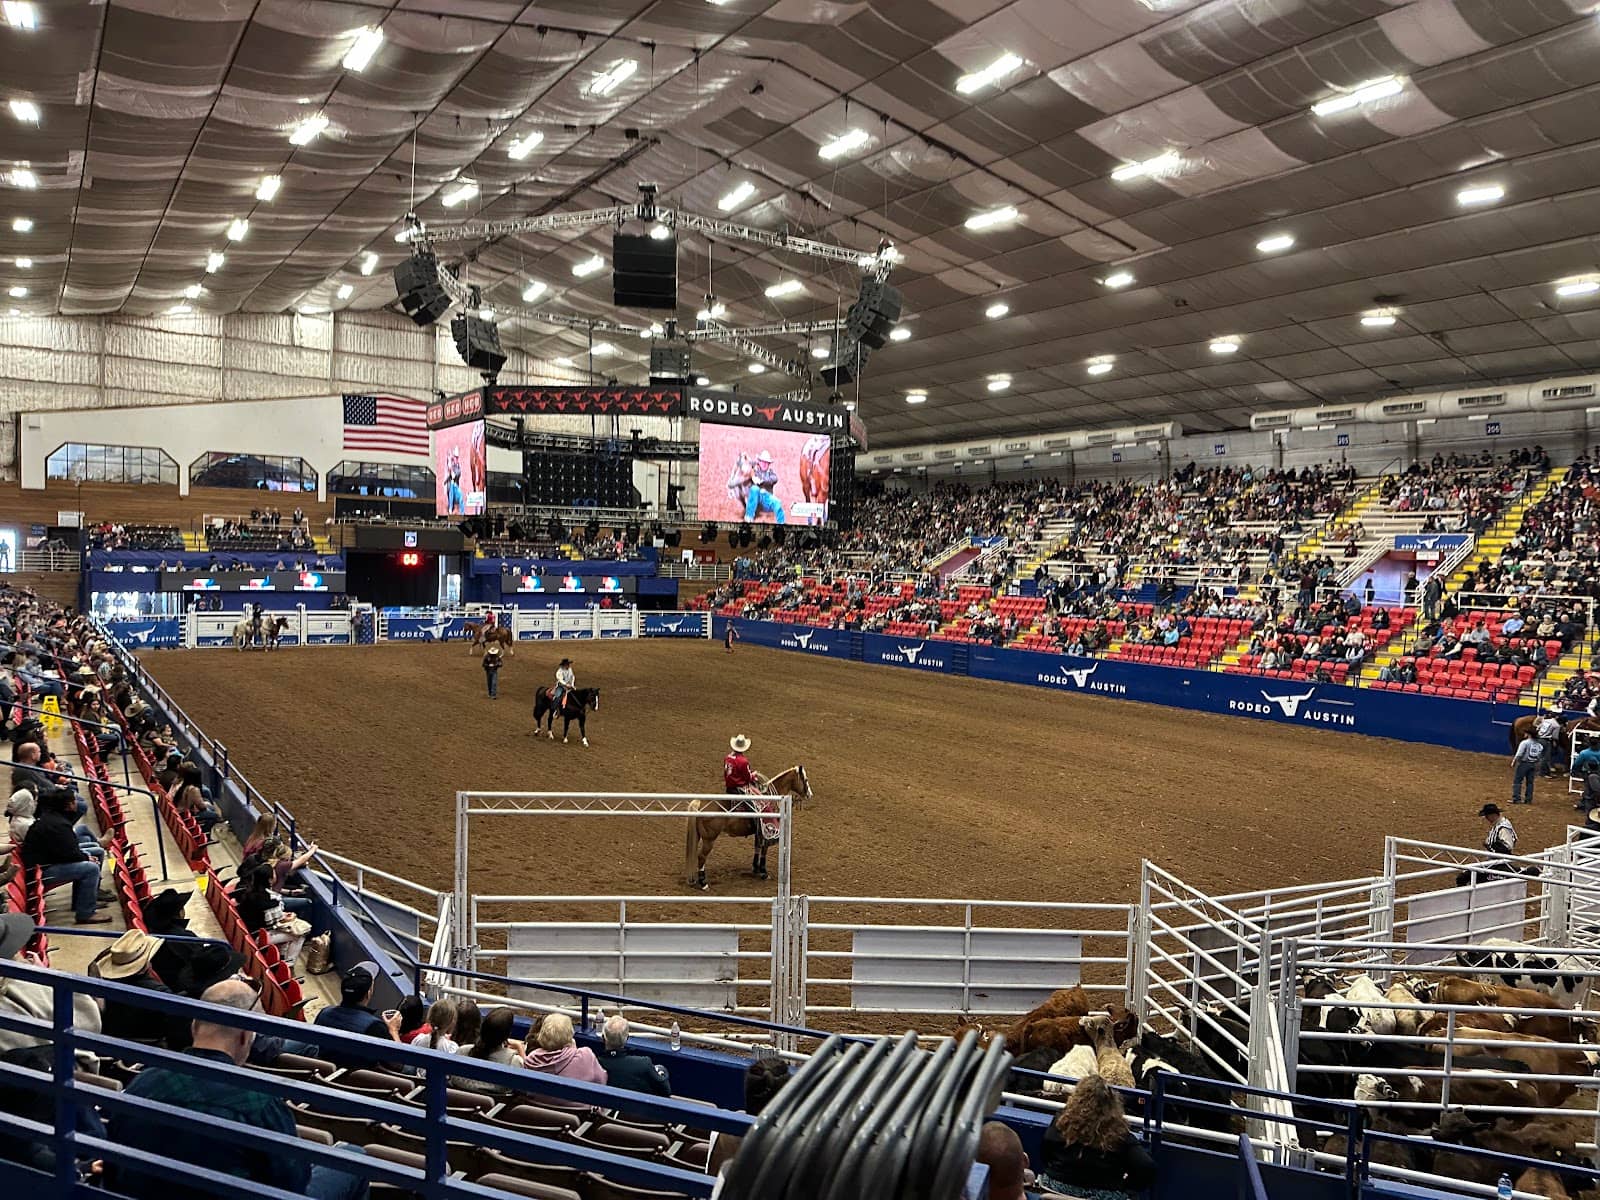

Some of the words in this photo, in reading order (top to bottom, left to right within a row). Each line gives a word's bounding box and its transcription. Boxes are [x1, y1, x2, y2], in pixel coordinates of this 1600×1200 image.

[689, 396, 754, 417] RODEO
[782, 408, 844, 428] AUSTIN
[151, 635, 177, 643] AUSTIN
[781, 639, 798, 648] RODEO
[808, 643, 829, 652] AUSTIN
[881, 652, 904, 662] RODEO
[918, 658, 944, 668] AUSTIN
[1037, 673, 1068, 686] RODEO
[1090, 681, 1127, 694] AUSTIN
[1229, 699, 1272, 715] RODEO
[1303, 709, 1356, 726] AUSTIN
